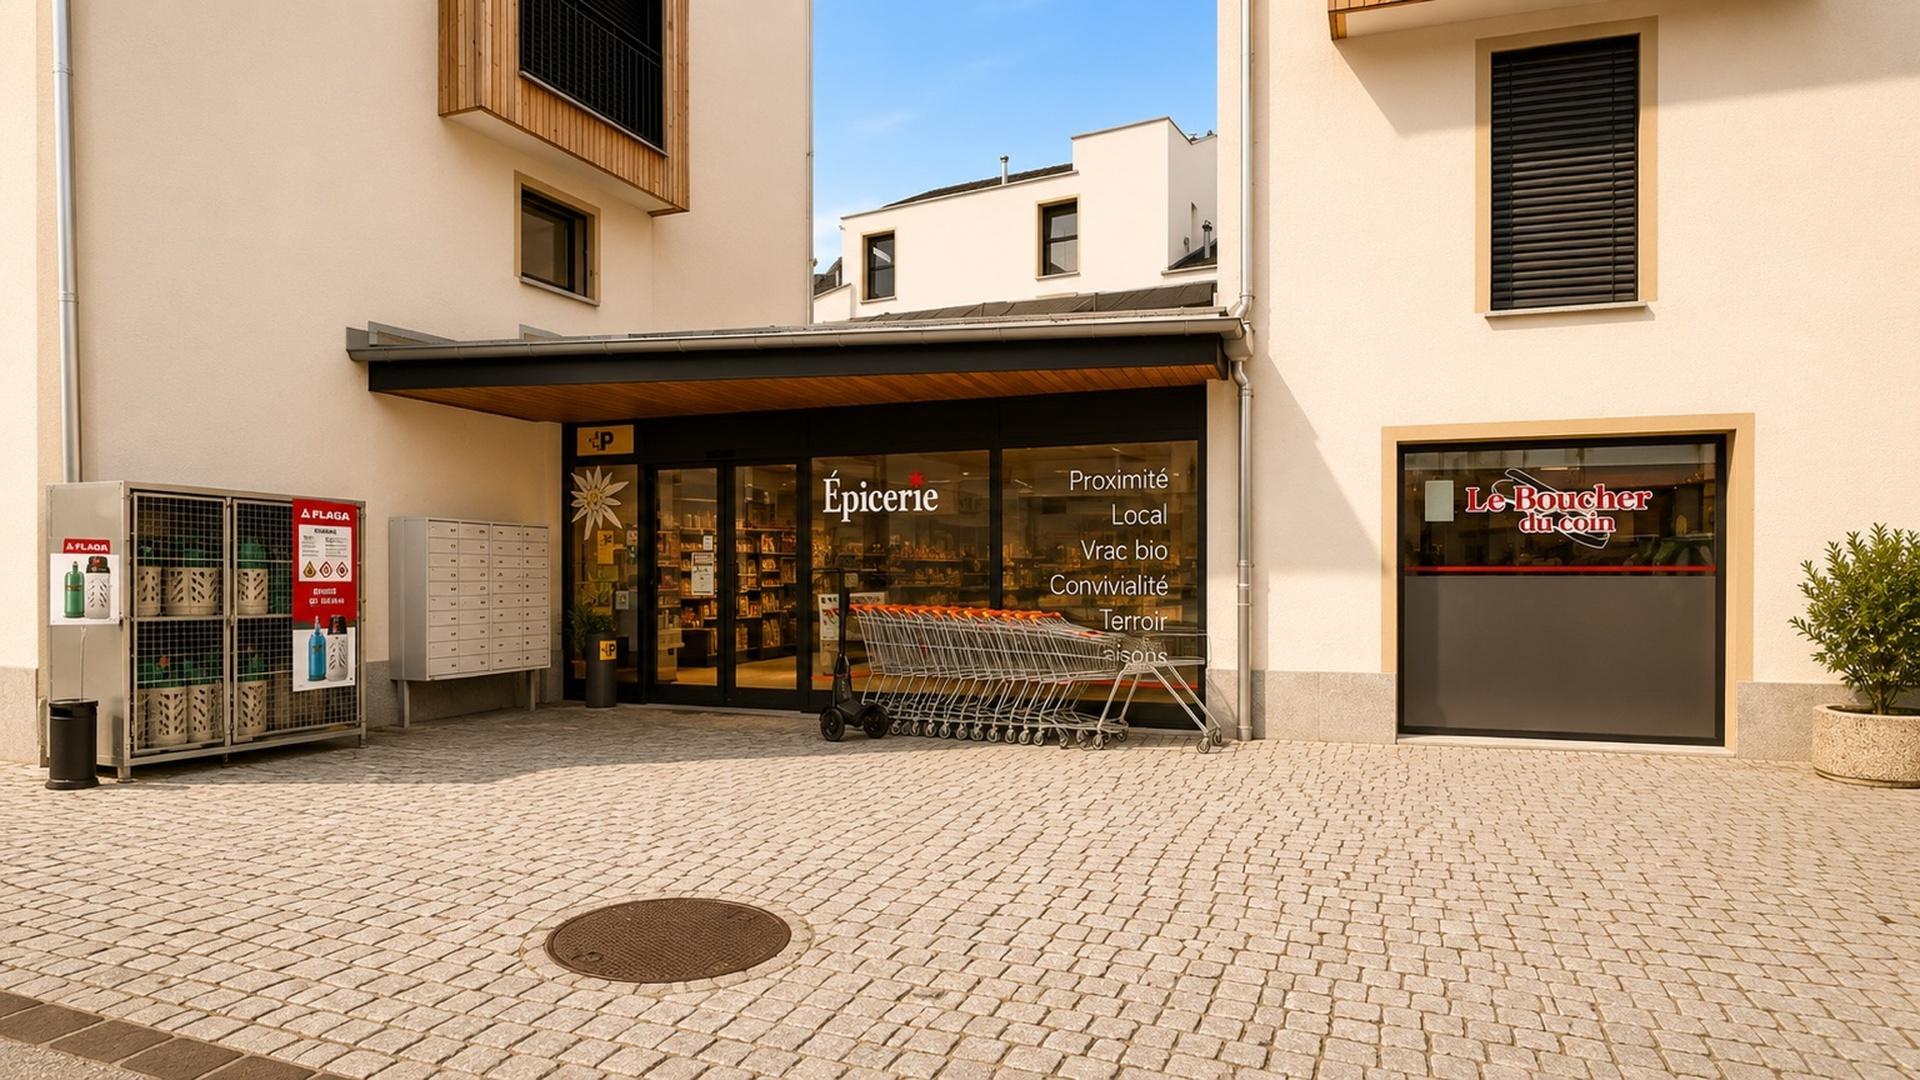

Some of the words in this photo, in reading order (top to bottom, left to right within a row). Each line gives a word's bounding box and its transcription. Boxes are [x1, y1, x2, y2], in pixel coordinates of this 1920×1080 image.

[1070, 467, 1169, 491] Proximité
[823, 469, 938, 522] Épicerie
[1465, 486, 1505, 513] Le
[1513, 483, 1653, 513] Boucher
[312, 509, 350, 521] FLAGA
[1112, 503, 1168, 525] Local
[1518, 511, 1554, 534] du
[1558, 511, 1616, 534] coin
[1081, 539, 1128, 561] Vrac
[1135, 539, 1169, 561] bio
[1050, 574, 1169, 597] Convivialité
[1099, 608, 1168, 631] Terroir
[1099, 643, 1169, 664] aisons
